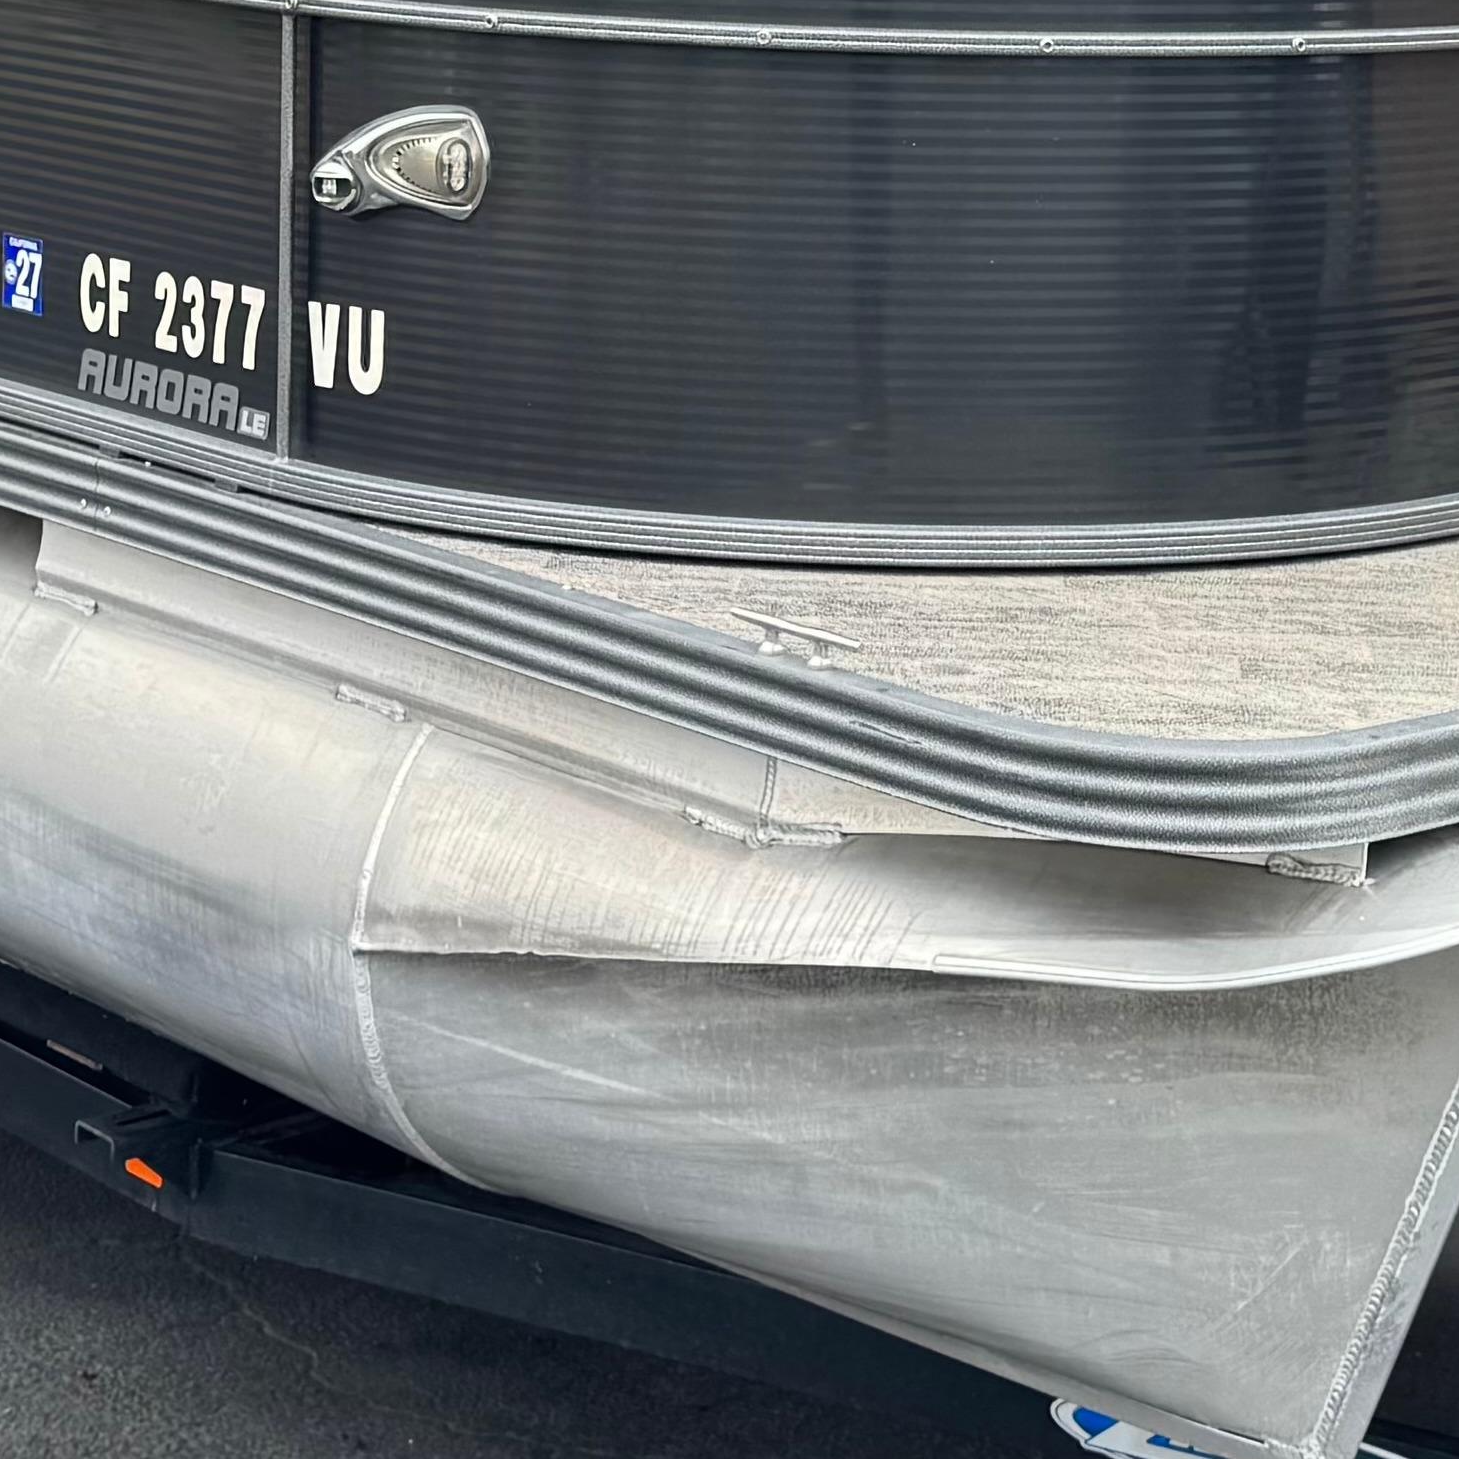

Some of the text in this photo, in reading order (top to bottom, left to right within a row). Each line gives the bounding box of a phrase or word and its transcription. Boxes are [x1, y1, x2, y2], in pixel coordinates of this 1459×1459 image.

[15, 249, 43, 300] 27
[79, 252, 386, 396] CF 2377 VU
[77, 347, 268, 437] AURORA LE
